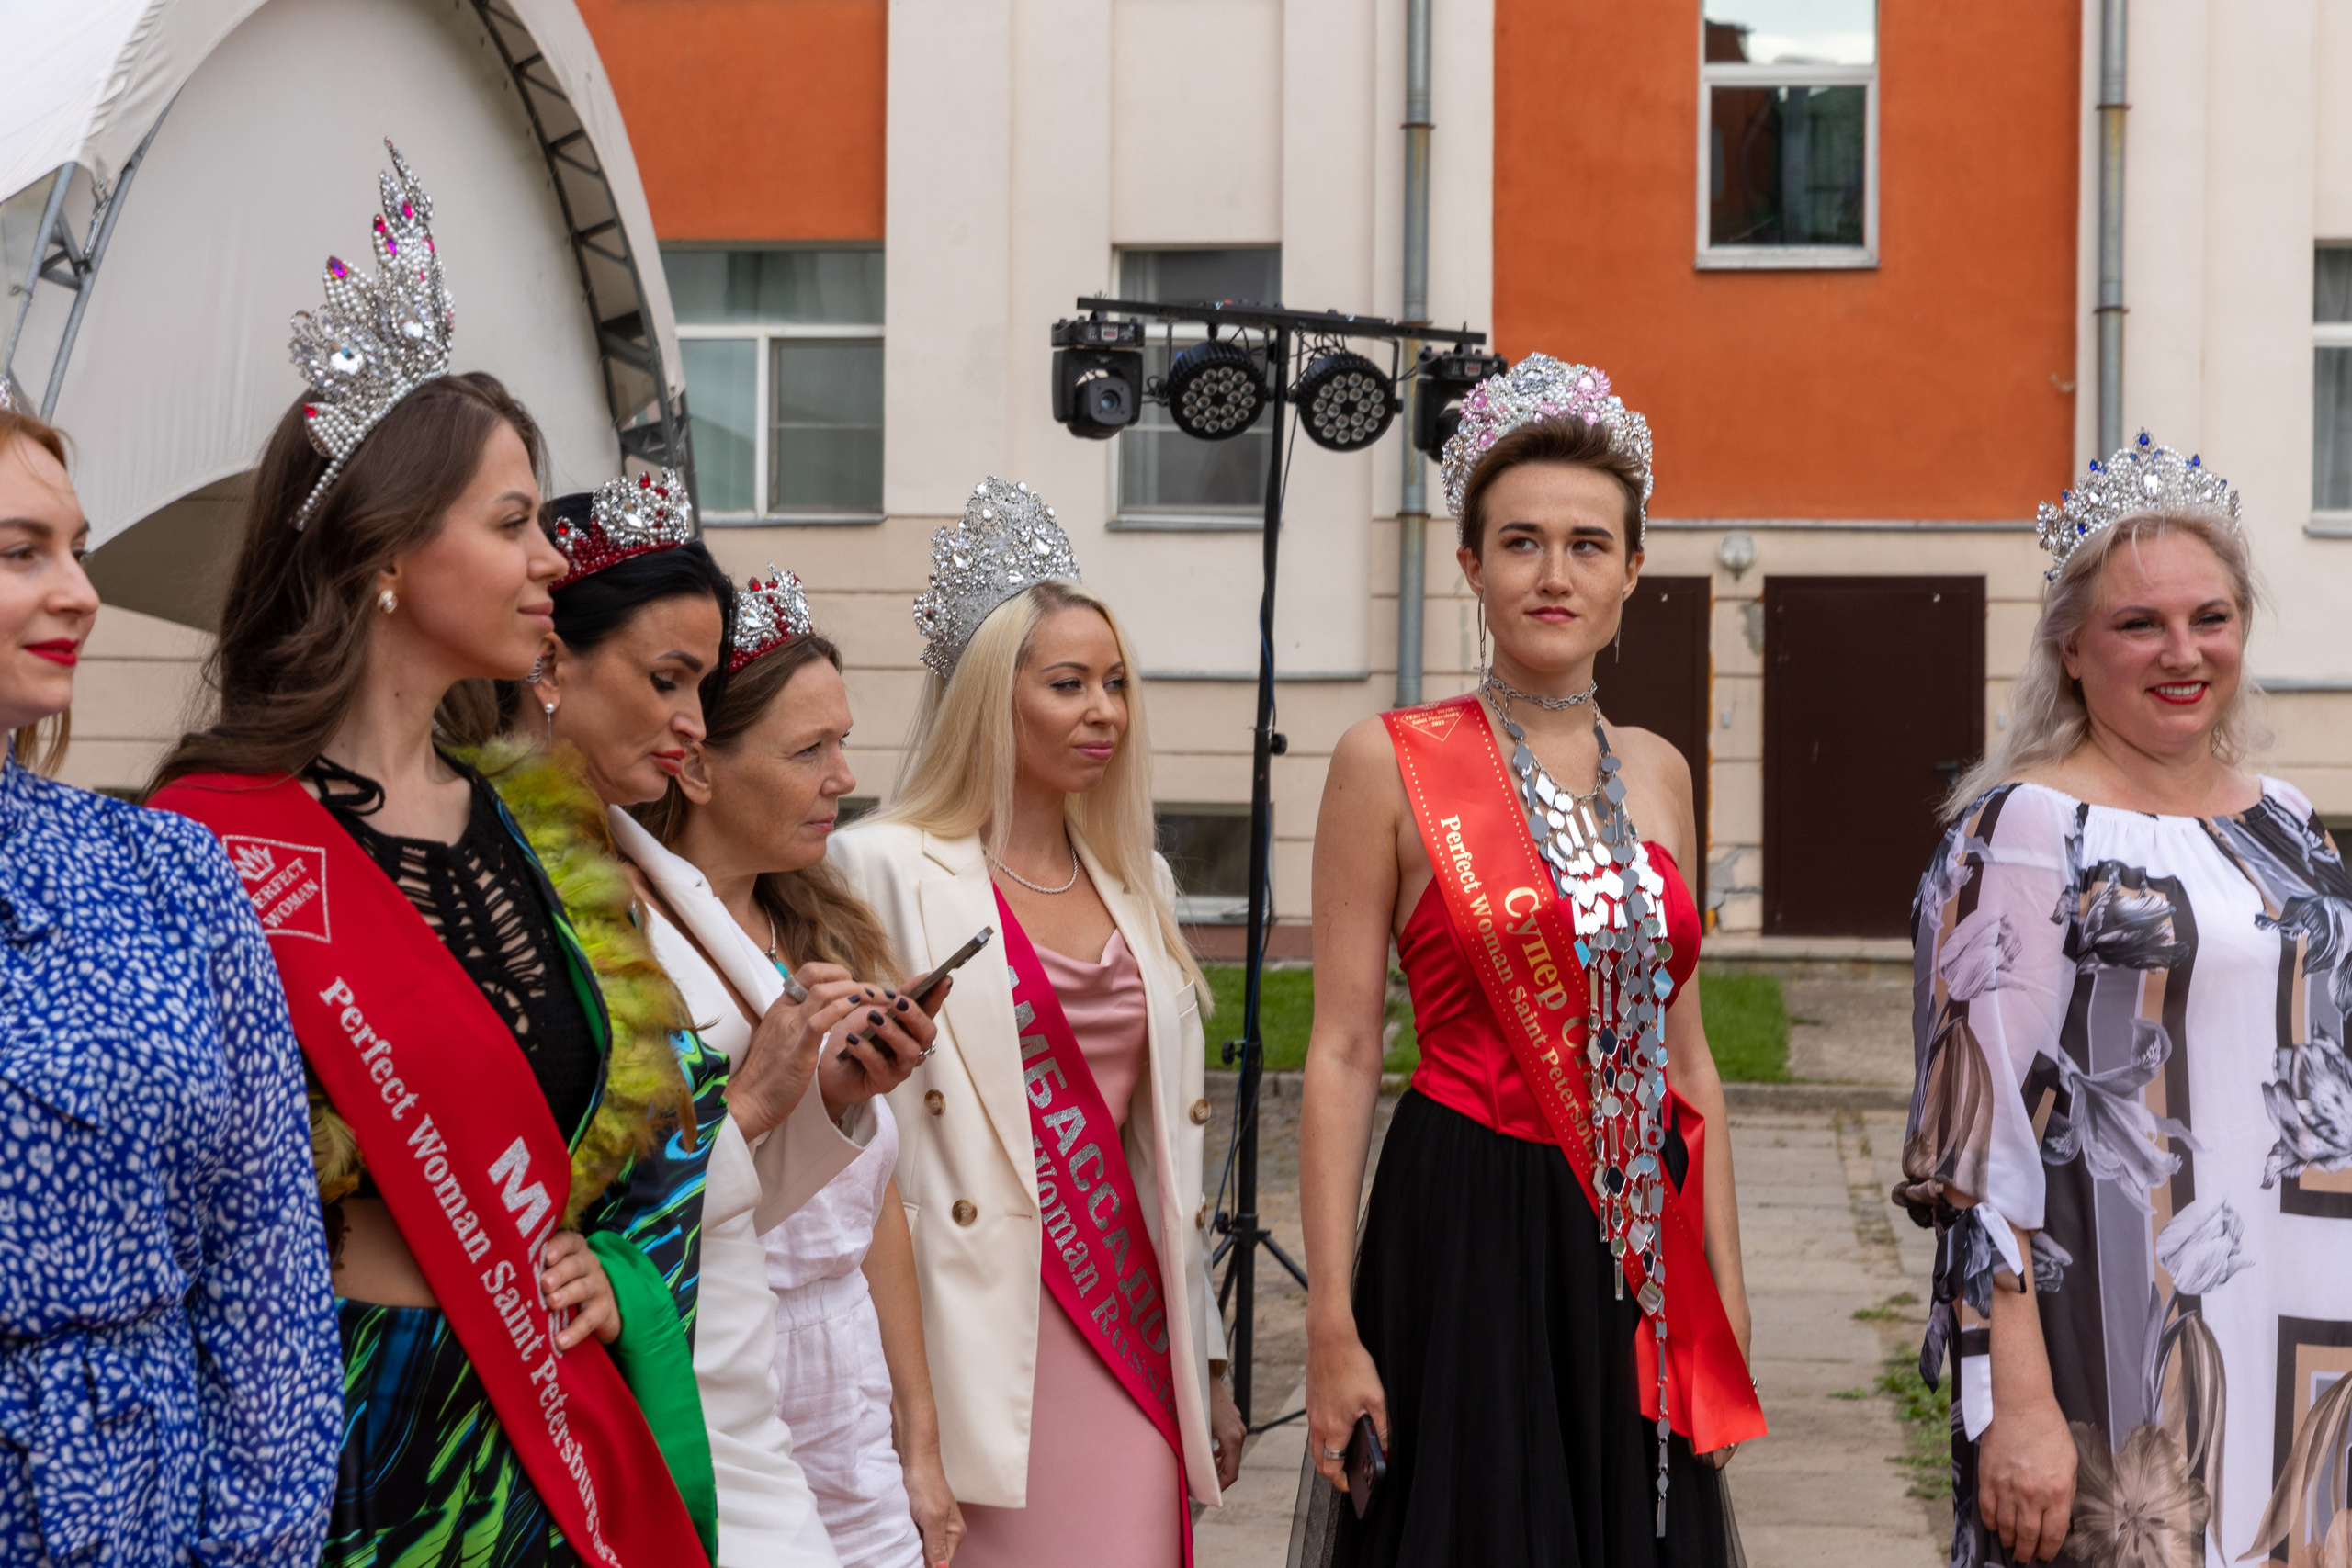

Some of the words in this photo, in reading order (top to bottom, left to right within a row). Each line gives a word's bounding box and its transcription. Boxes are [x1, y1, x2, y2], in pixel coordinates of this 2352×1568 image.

[250, 856, 308, 910] ERFECT
[263, 877, 320, 928] WOMAN
[1440, 814, 1483, 894] Perfect
[1469, 892, 1514, 984] Woman
[1508, 985, 1549, 1048] Saint
[1505, 886, 1567, 1011] Супер
[319, 976, 420, 1121] Perfect
[406, 1113, 492, 1264] Woman
[480, 1259, 546, 1362] Saint
[529, 1354, 598, 1533] Petersburg
